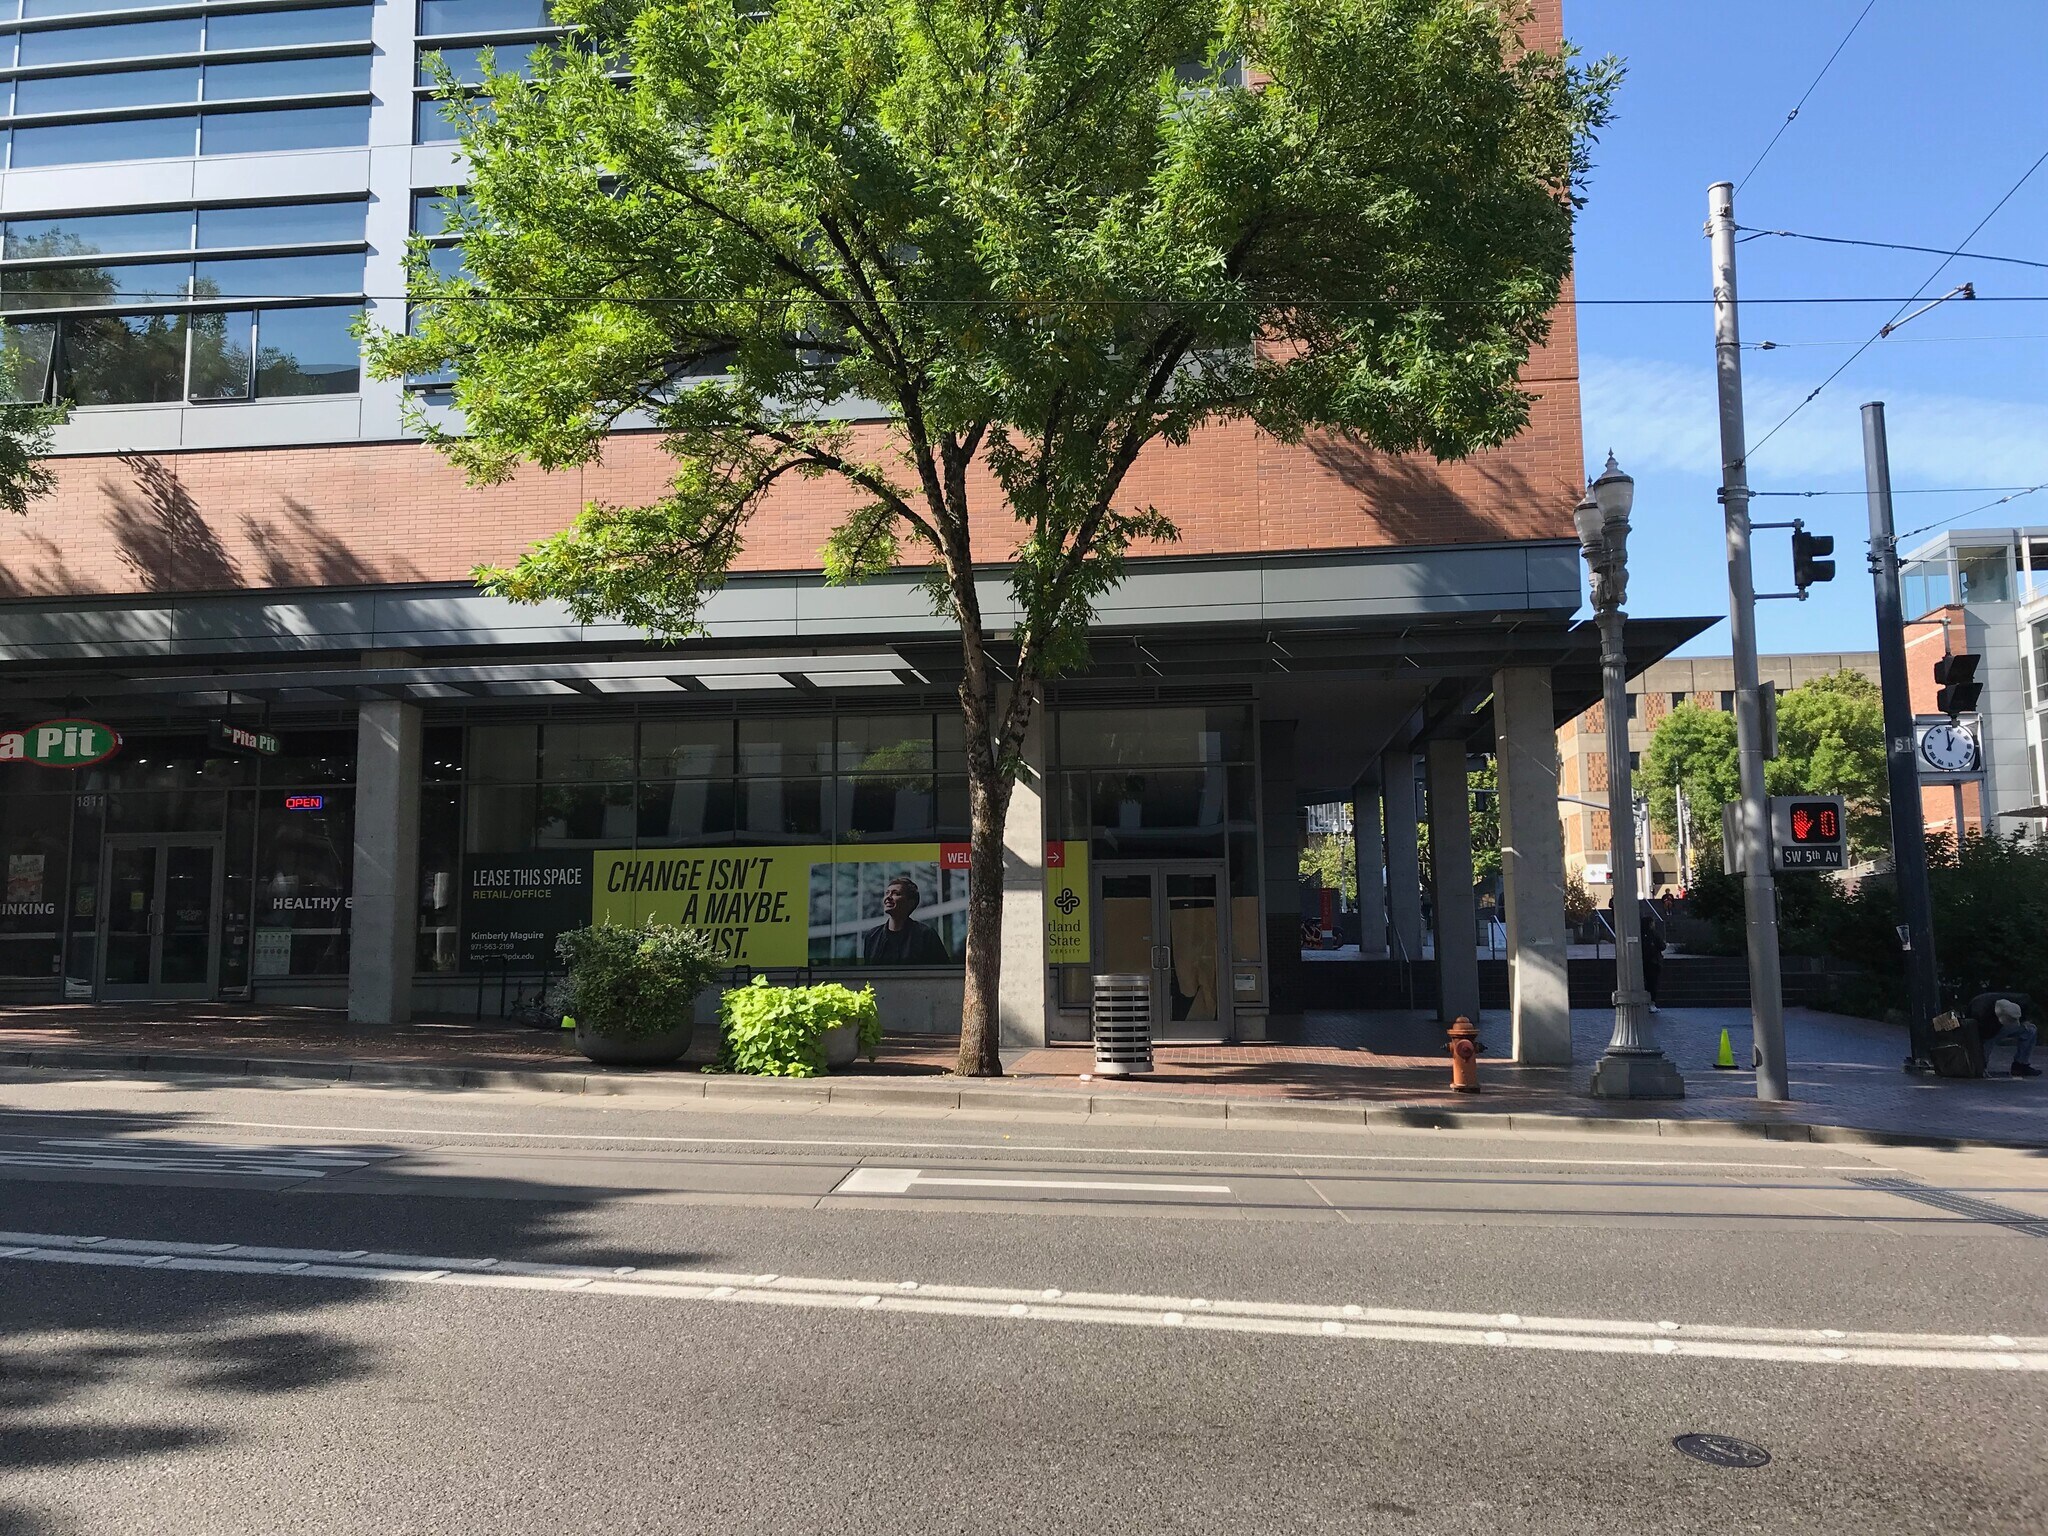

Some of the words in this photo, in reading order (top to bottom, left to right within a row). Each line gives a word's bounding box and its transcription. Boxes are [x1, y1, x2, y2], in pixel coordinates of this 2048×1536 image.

[36, 727, 95, 757] Pit
[232, 729, 257, 748] Pita
[259, 735, 275, 752] Pit
[77, 795, 104, 807] 1811
[286, 798, 319, 808] OPEN
[1785, 851, 1802, 863] SW
[1806, 850, 1821, 863] 5th
[1825, 850, 1838, 862] Av
[473, 869, 510, 887] LEASE
[513, 868, 540, 886] THIS
[543, 867, 582, 885] SPACE
[606, 859, 704, 892] CHANGE
[706, 857, 773, 890] ISN'T
[472, 889, 552, 899] RETAIL/OFFICE
[1, 903, 55, 915] INKING
[273, 897, 341, 912] HEALTHY
[680, 893, 699, 924] A
[703, 891, 791, 924] MAYBE.
[471, 931, 509, 942] Kimberly
[510, 931, 544, 941] Maguire
[694, 927, 749, 959] UST.
[1049, 933, 1081, 947] State
[470, 943, 514, 951] 971-563-2199
